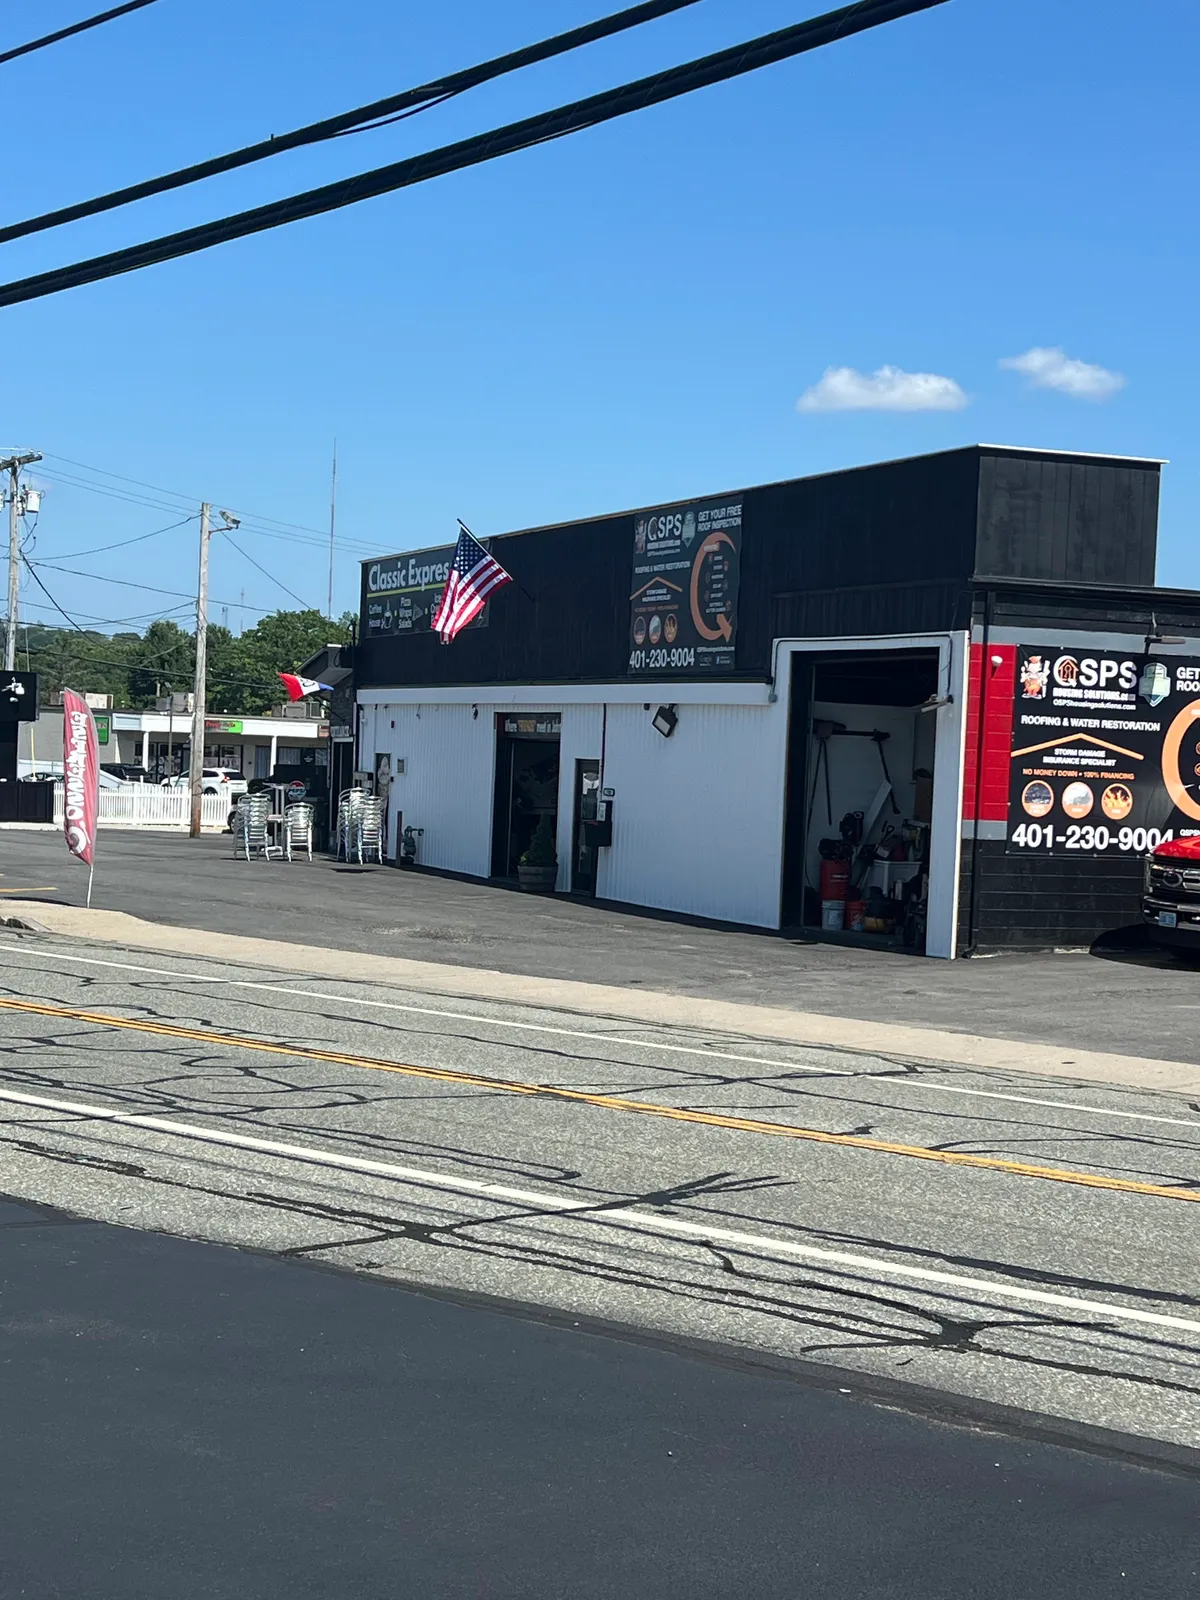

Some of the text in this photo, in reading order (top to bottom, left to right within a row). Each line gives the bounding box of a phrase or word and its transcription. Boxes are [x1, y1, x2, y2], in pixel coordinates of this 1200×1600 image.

[698, 504, 742, 521] GET YOUR FREE
[648, 514, 682, 541] QSPS
[697, 521, 711, 532] ROOF
[369, 558, 450, 592] Classic Expres
[629, 647, 695, 668] 401-230-9004
[1053, 655, 1137, 689] QSPS
[1176, 666, 1200, 680] GET
[1176, 680, 1200, 692] ROO
[1020, 715, 1161, 731] ROOFING & WATER RESTORATION
[1033, 768, 1057, 777] MONEY
[1011, 823, 1173, 851] 401-230-9004
